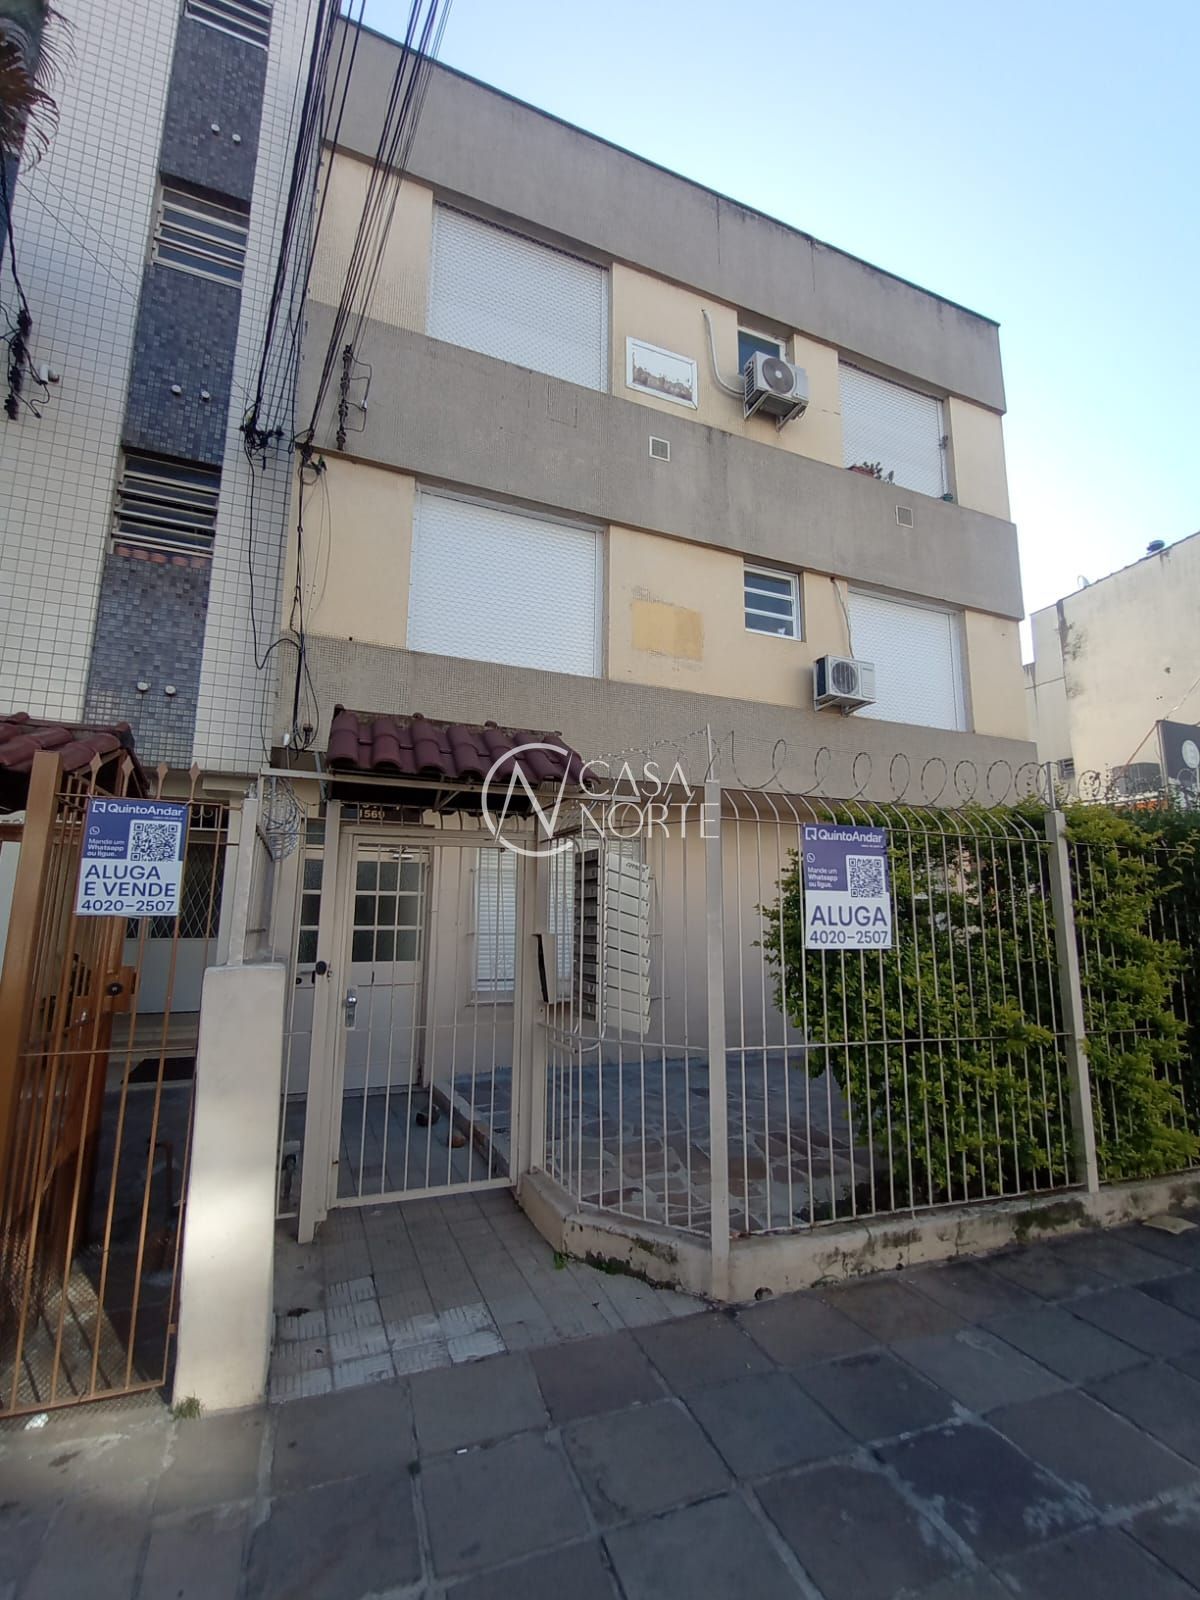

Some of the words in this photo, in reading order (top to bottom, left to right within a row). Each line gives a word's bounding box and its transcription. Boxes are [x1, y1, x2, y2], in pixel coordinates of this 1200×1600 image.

[107, 803, 184, 816] QuintoAndar
[818, 828, 882, 843] QuintoAndar
[84, 863, 161, 880] ALUGA
[83, 881, 97, 897] E
[102, 881, 177, 898] VENDE
[80, 899, 175, 912] 4020-2507
[810, 905, 888, 927] ALUGA
[809, 930, 889, 944] 4020-2507
